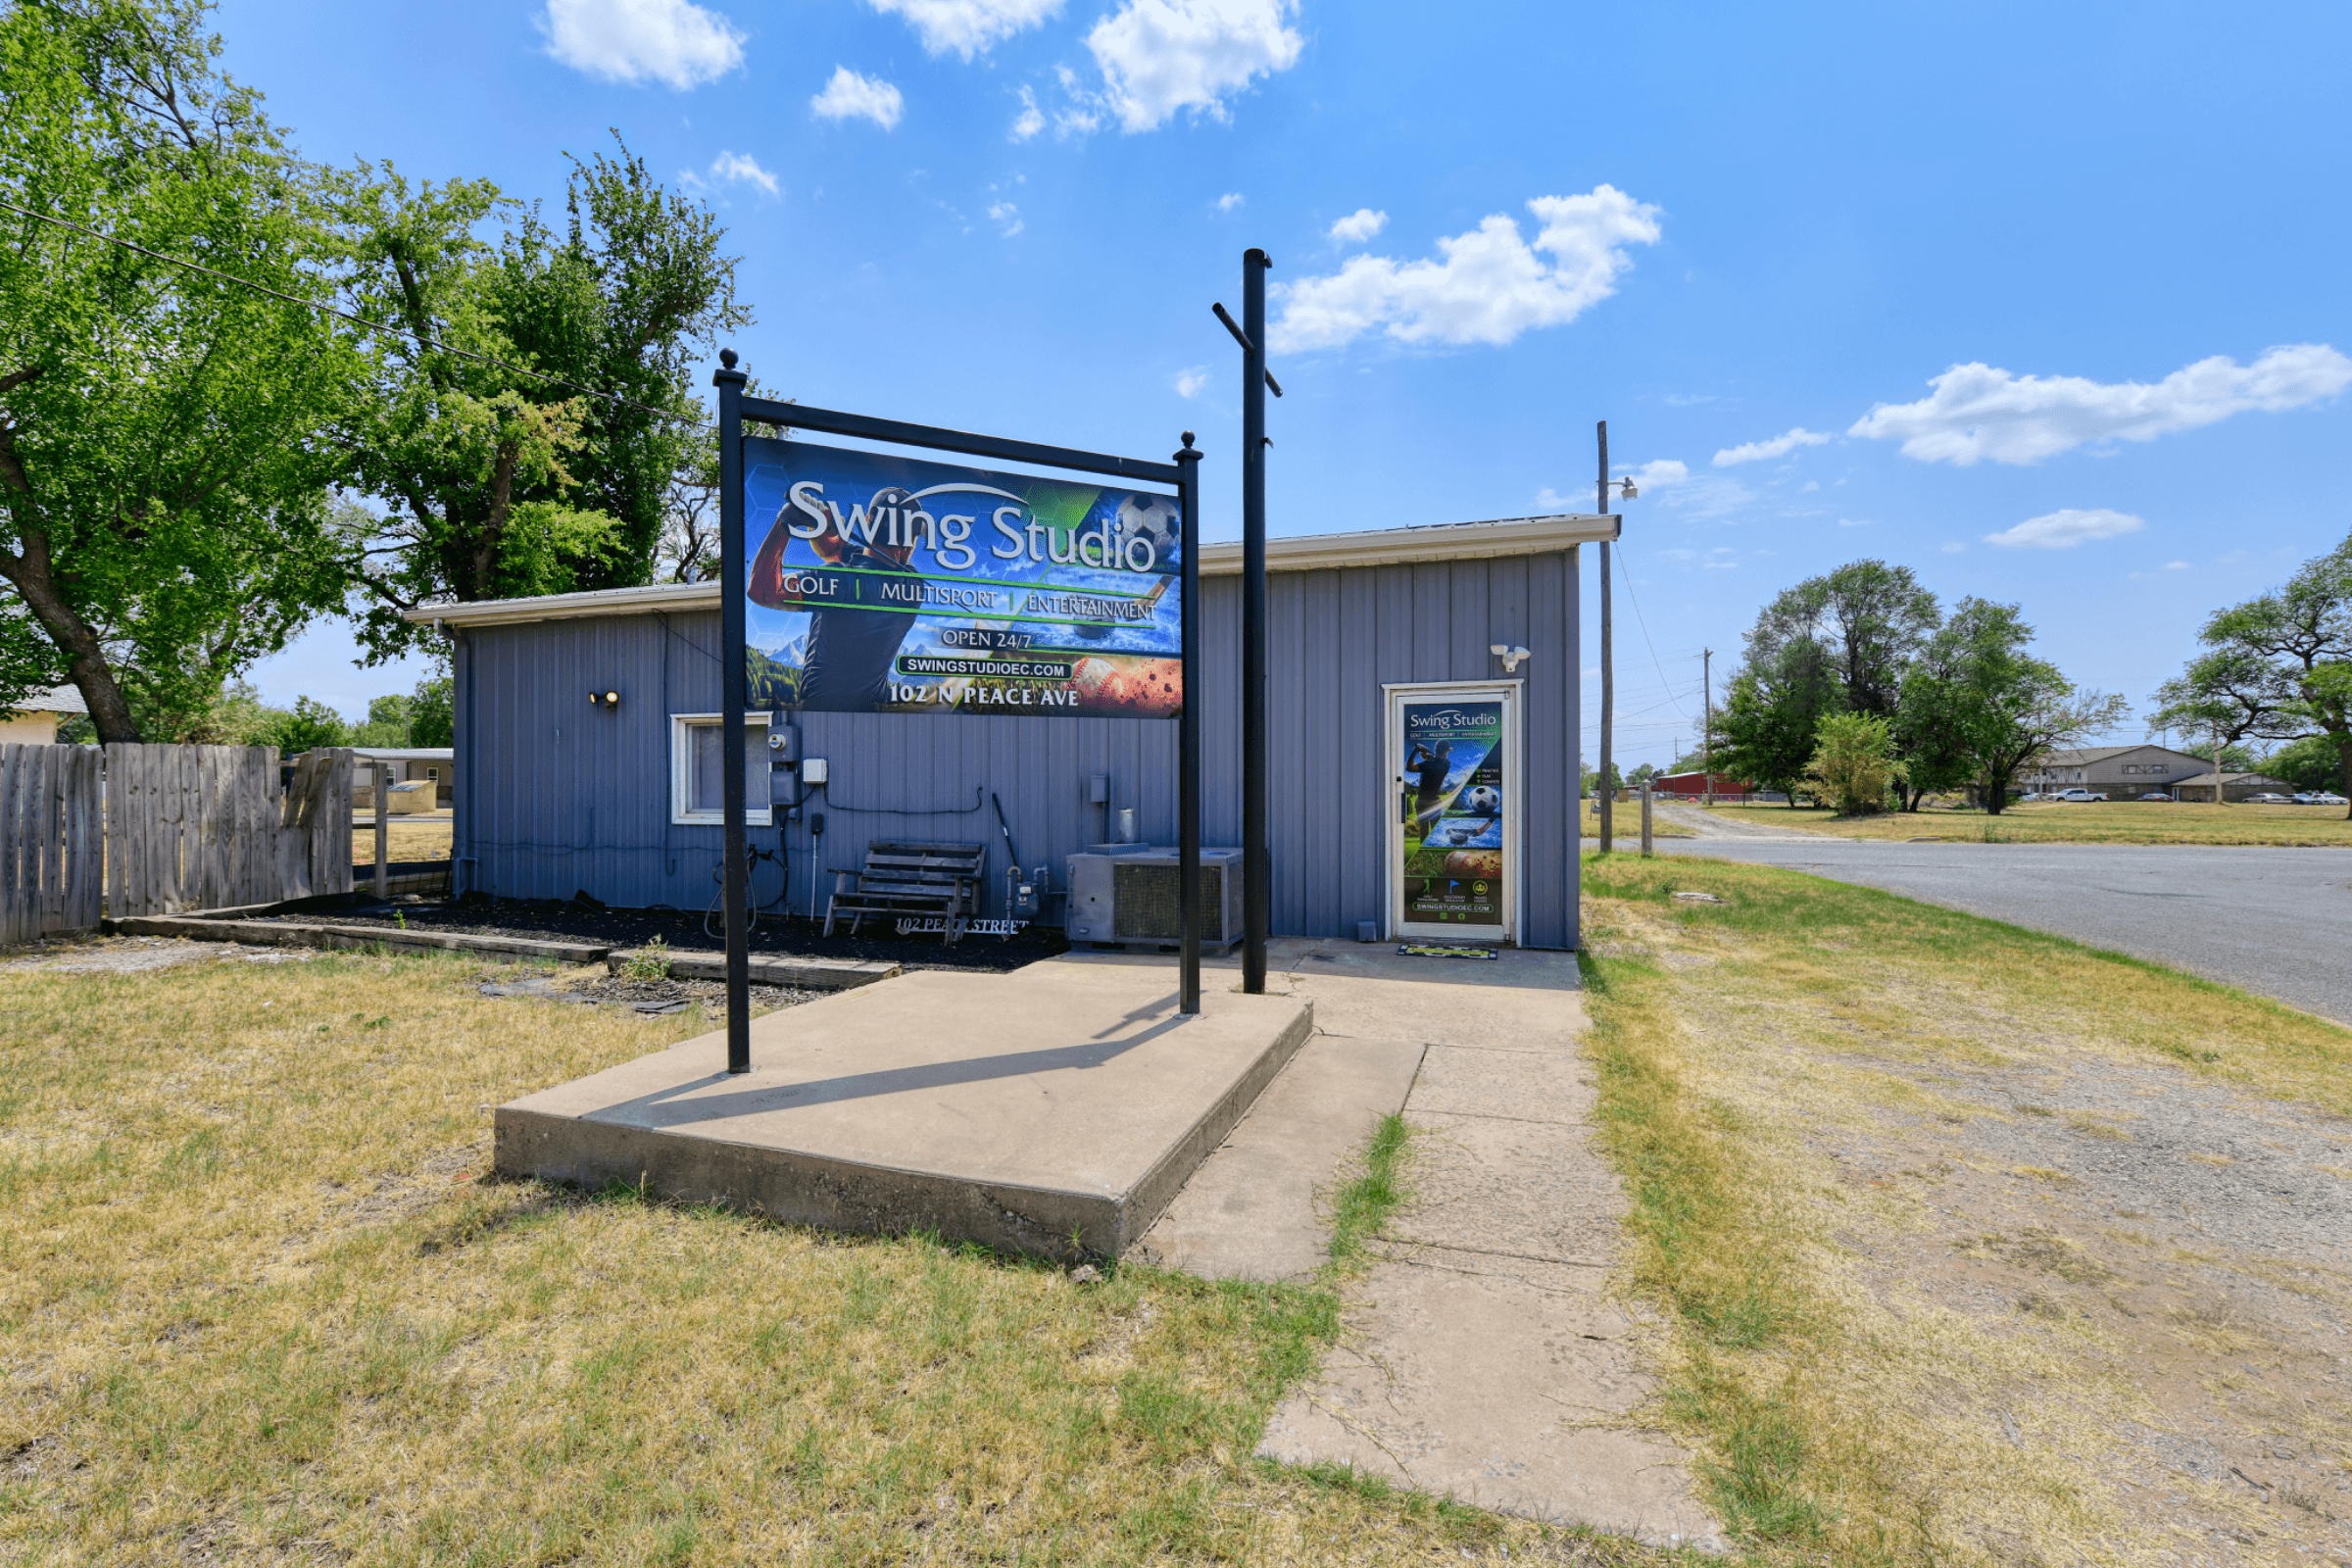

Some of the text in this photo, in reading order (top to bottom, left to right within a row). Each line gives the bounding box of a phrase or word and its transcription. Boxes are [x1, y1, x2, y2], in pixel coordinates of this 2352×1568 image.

[787, 480, 1155, 572] Swing Studio
[784, 573, 1156, 620] GOLF MULTISPORT ENTERTAINMENT
[942, 630, 1032, 650] OPEN 24/7
[906, 660, 1065, 677] SWINGSTUDIOEC.COM
[891, 686, 1079, 707] 102 N PEACE AVE
[1410, 712, 1496, 729] Swing Studio
[896, 917, 920, 930] 102
